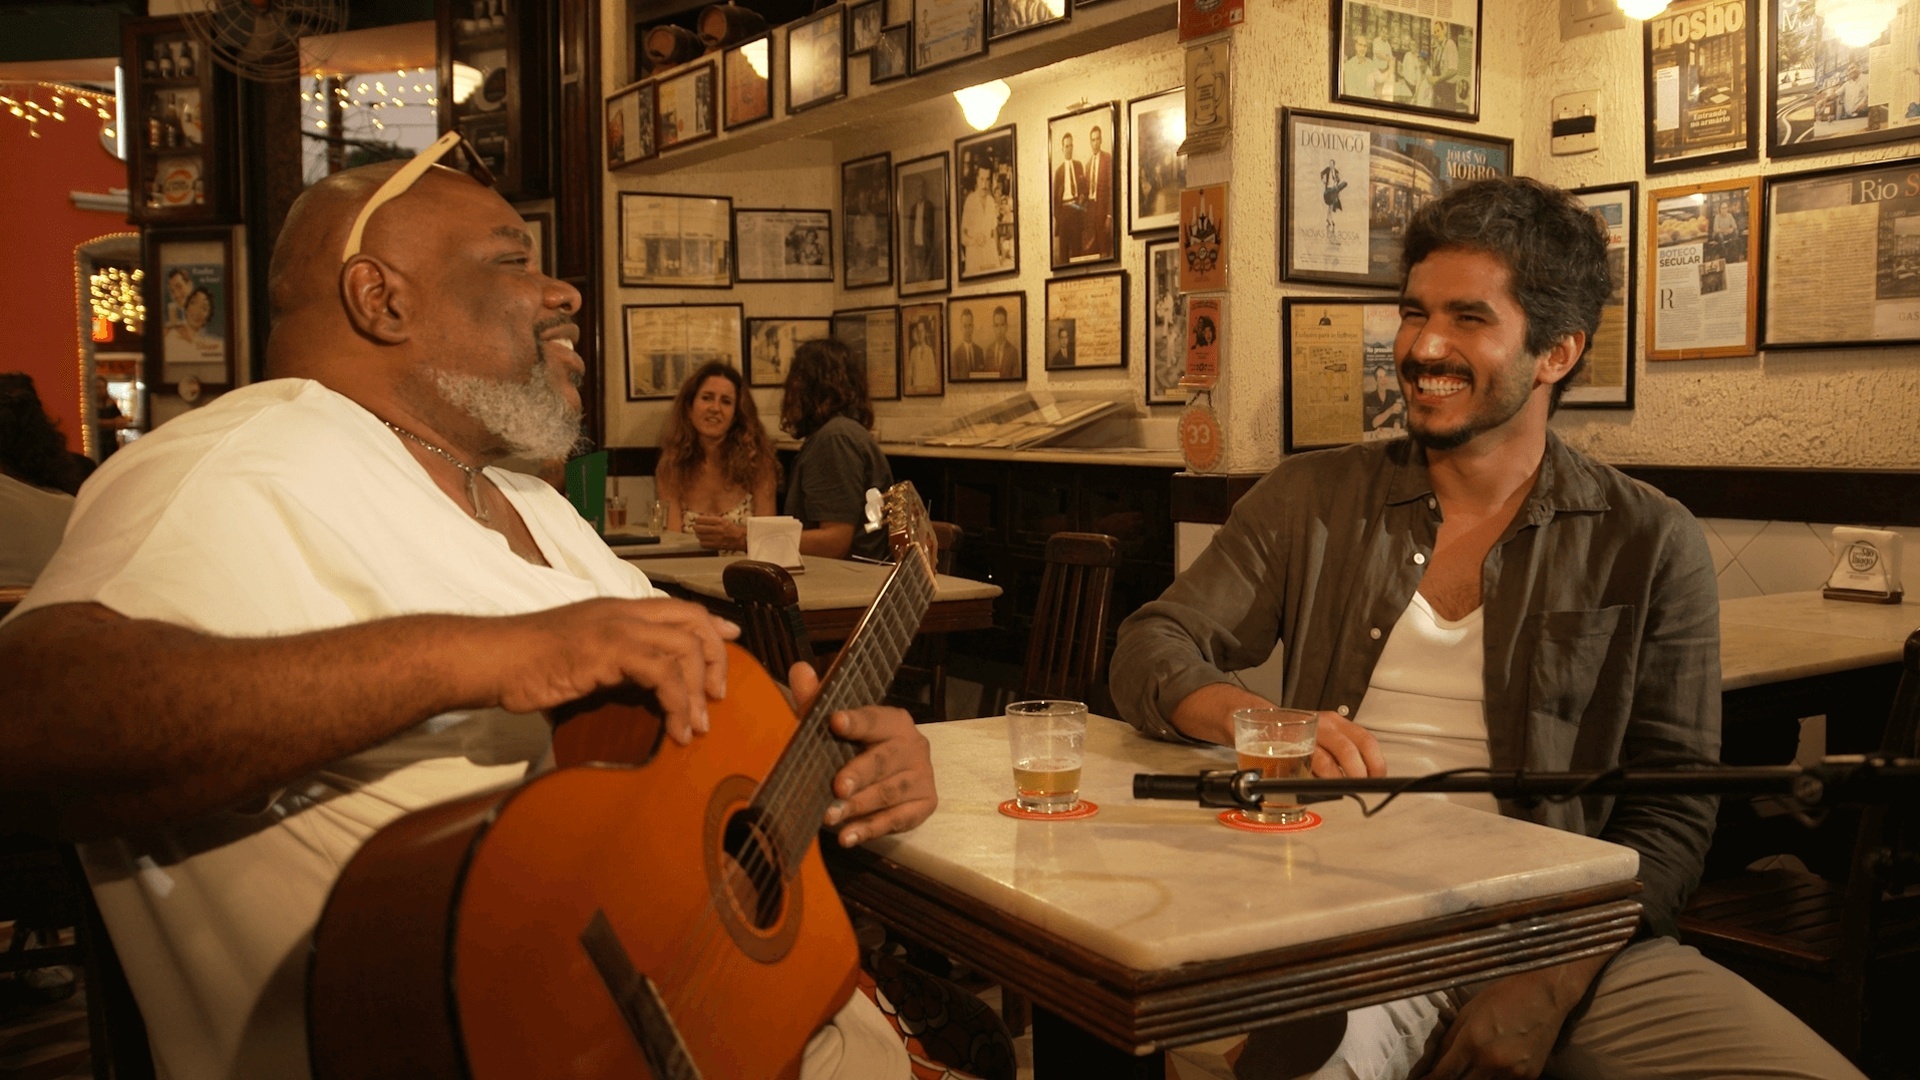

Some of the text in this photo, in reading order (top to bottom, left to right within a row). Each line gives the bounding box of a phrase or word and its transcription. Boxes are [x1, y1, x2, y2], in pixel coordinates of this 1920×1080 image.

[1693, 109, 1727, 121] Entrando
[1301, 130, 1364, 153] DOMINGO
[1446, 161, 1496, 181] MORRO
[1860, 178, 1899, 203] Rio
[1659, 246, 1697, 259] BOTECO
[1659, 255, 1701, 268] SECULAR
[1187, 423, 1211, 446] 33
